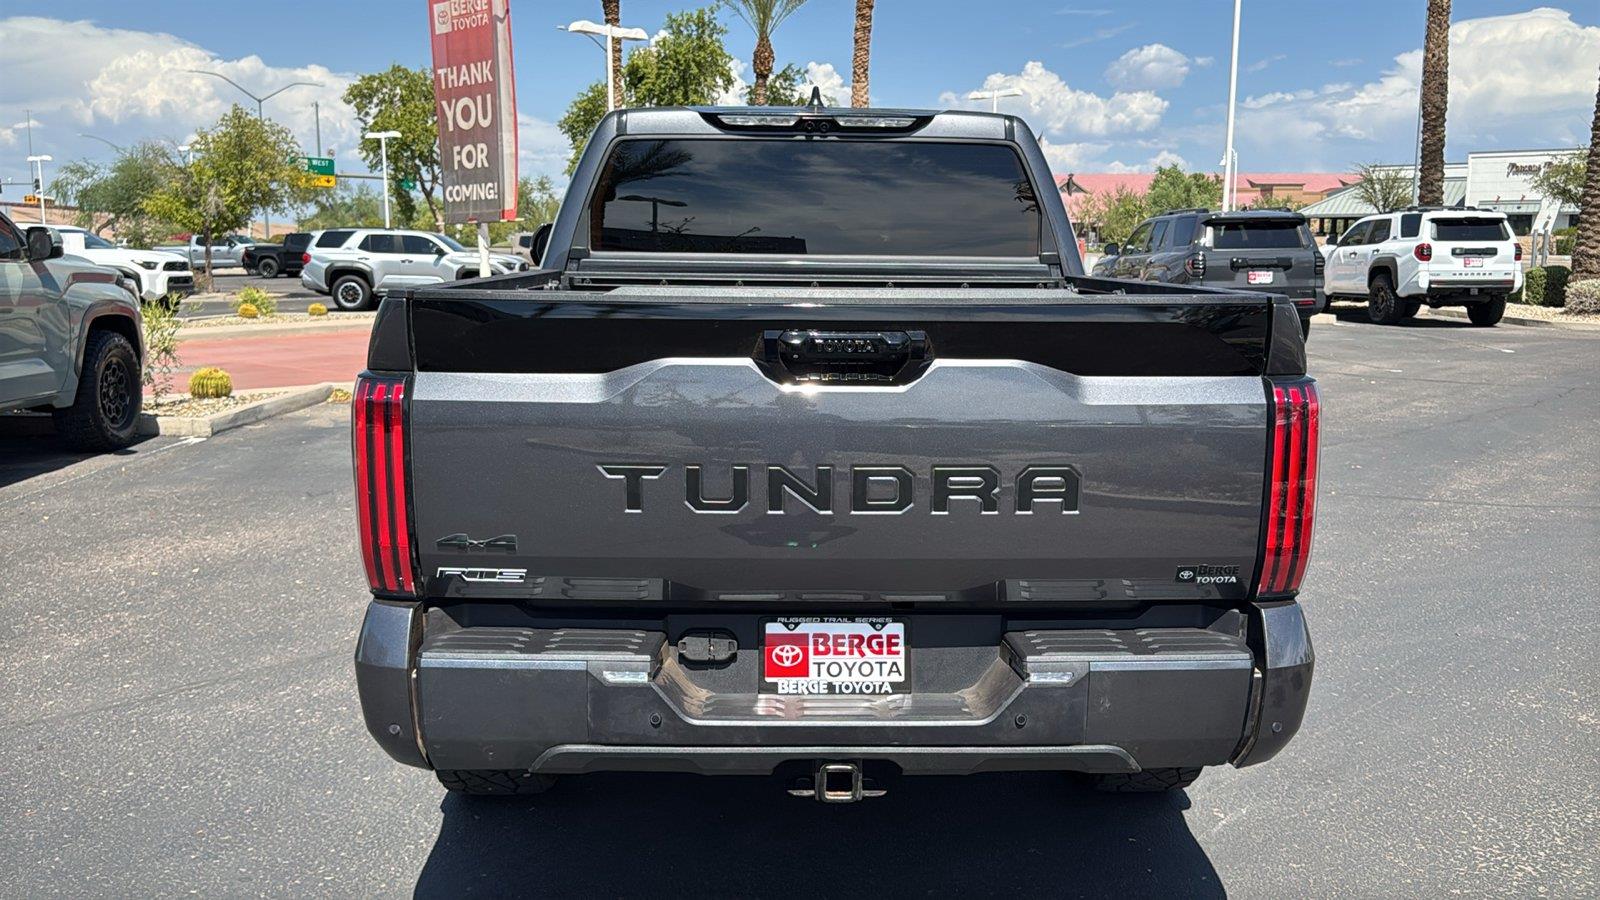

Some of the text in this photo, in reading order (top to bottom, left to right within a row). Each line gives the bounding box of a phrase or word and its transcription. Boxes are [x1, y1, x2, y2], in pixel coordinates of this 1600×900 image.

[450, 0, 489, 17] BERGE
[451, 13, 490, 31] TOYOTA
[437, 59, 494, 90] THANK
[440, 93, 493, 132] YOU
[452, 142, 489, 171] FOR
[445, 182, 499, 203] COMING!
[814, 339, 875, 353] TOYOTA
[595, 465, 1081, 515] TUNDRA
[1198, 563, 1241, 576] BERGE
[1195, 576, 1238, 584] TOYOTA
[777, 616, 893, 624] RUGGED TRAIL SERIES
[812, 632, 901, 658] BERGE
[812, 661, 903, 678] TOYOTA
[777, 679, 893, 695] BERGE TOYOTA
